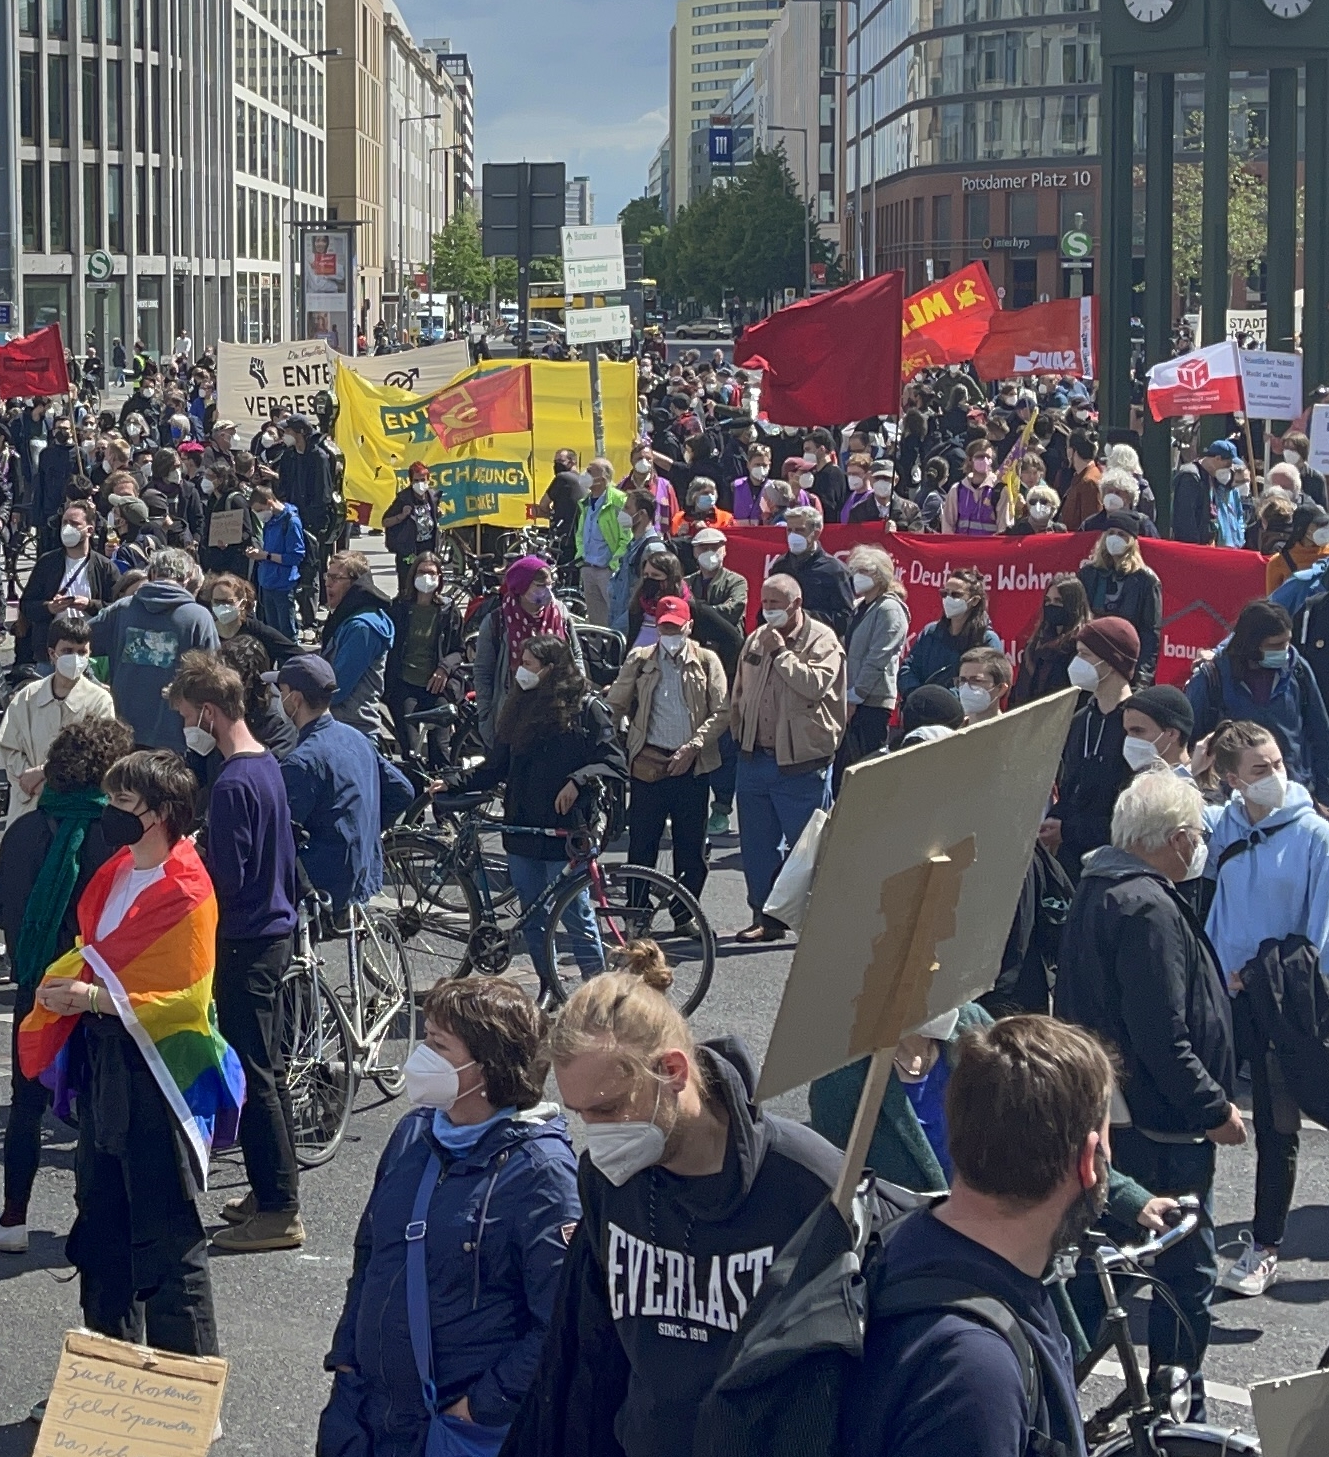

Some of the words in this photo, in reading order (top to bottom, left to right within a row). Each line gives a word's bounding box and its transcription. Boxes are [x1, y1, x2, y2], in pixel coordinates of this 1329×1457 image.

[962, 174, 1027, 191] Potsdamer
[1031, 172, 1067, 188] Platz
[1072, 170, 1091, 187] 10
[993, 237, 1030, 249] interhyp
[1067, 232, 1088, 257] S
[91, 252, 110, 279] S
[1229, 317, 1267, 329] STADT
[910, 560, 992, 591] Deute
[997, 562, 1076, 591] Wohn
[608, 1221, 774, 1333] EVERLAST
[657, 1322, 688, 1339] SINCE
[689, 1327, 709, 1342] 1910
[64, 1361, 128, 1391] Suche
[62, 1393, 119, 1420] Geld
